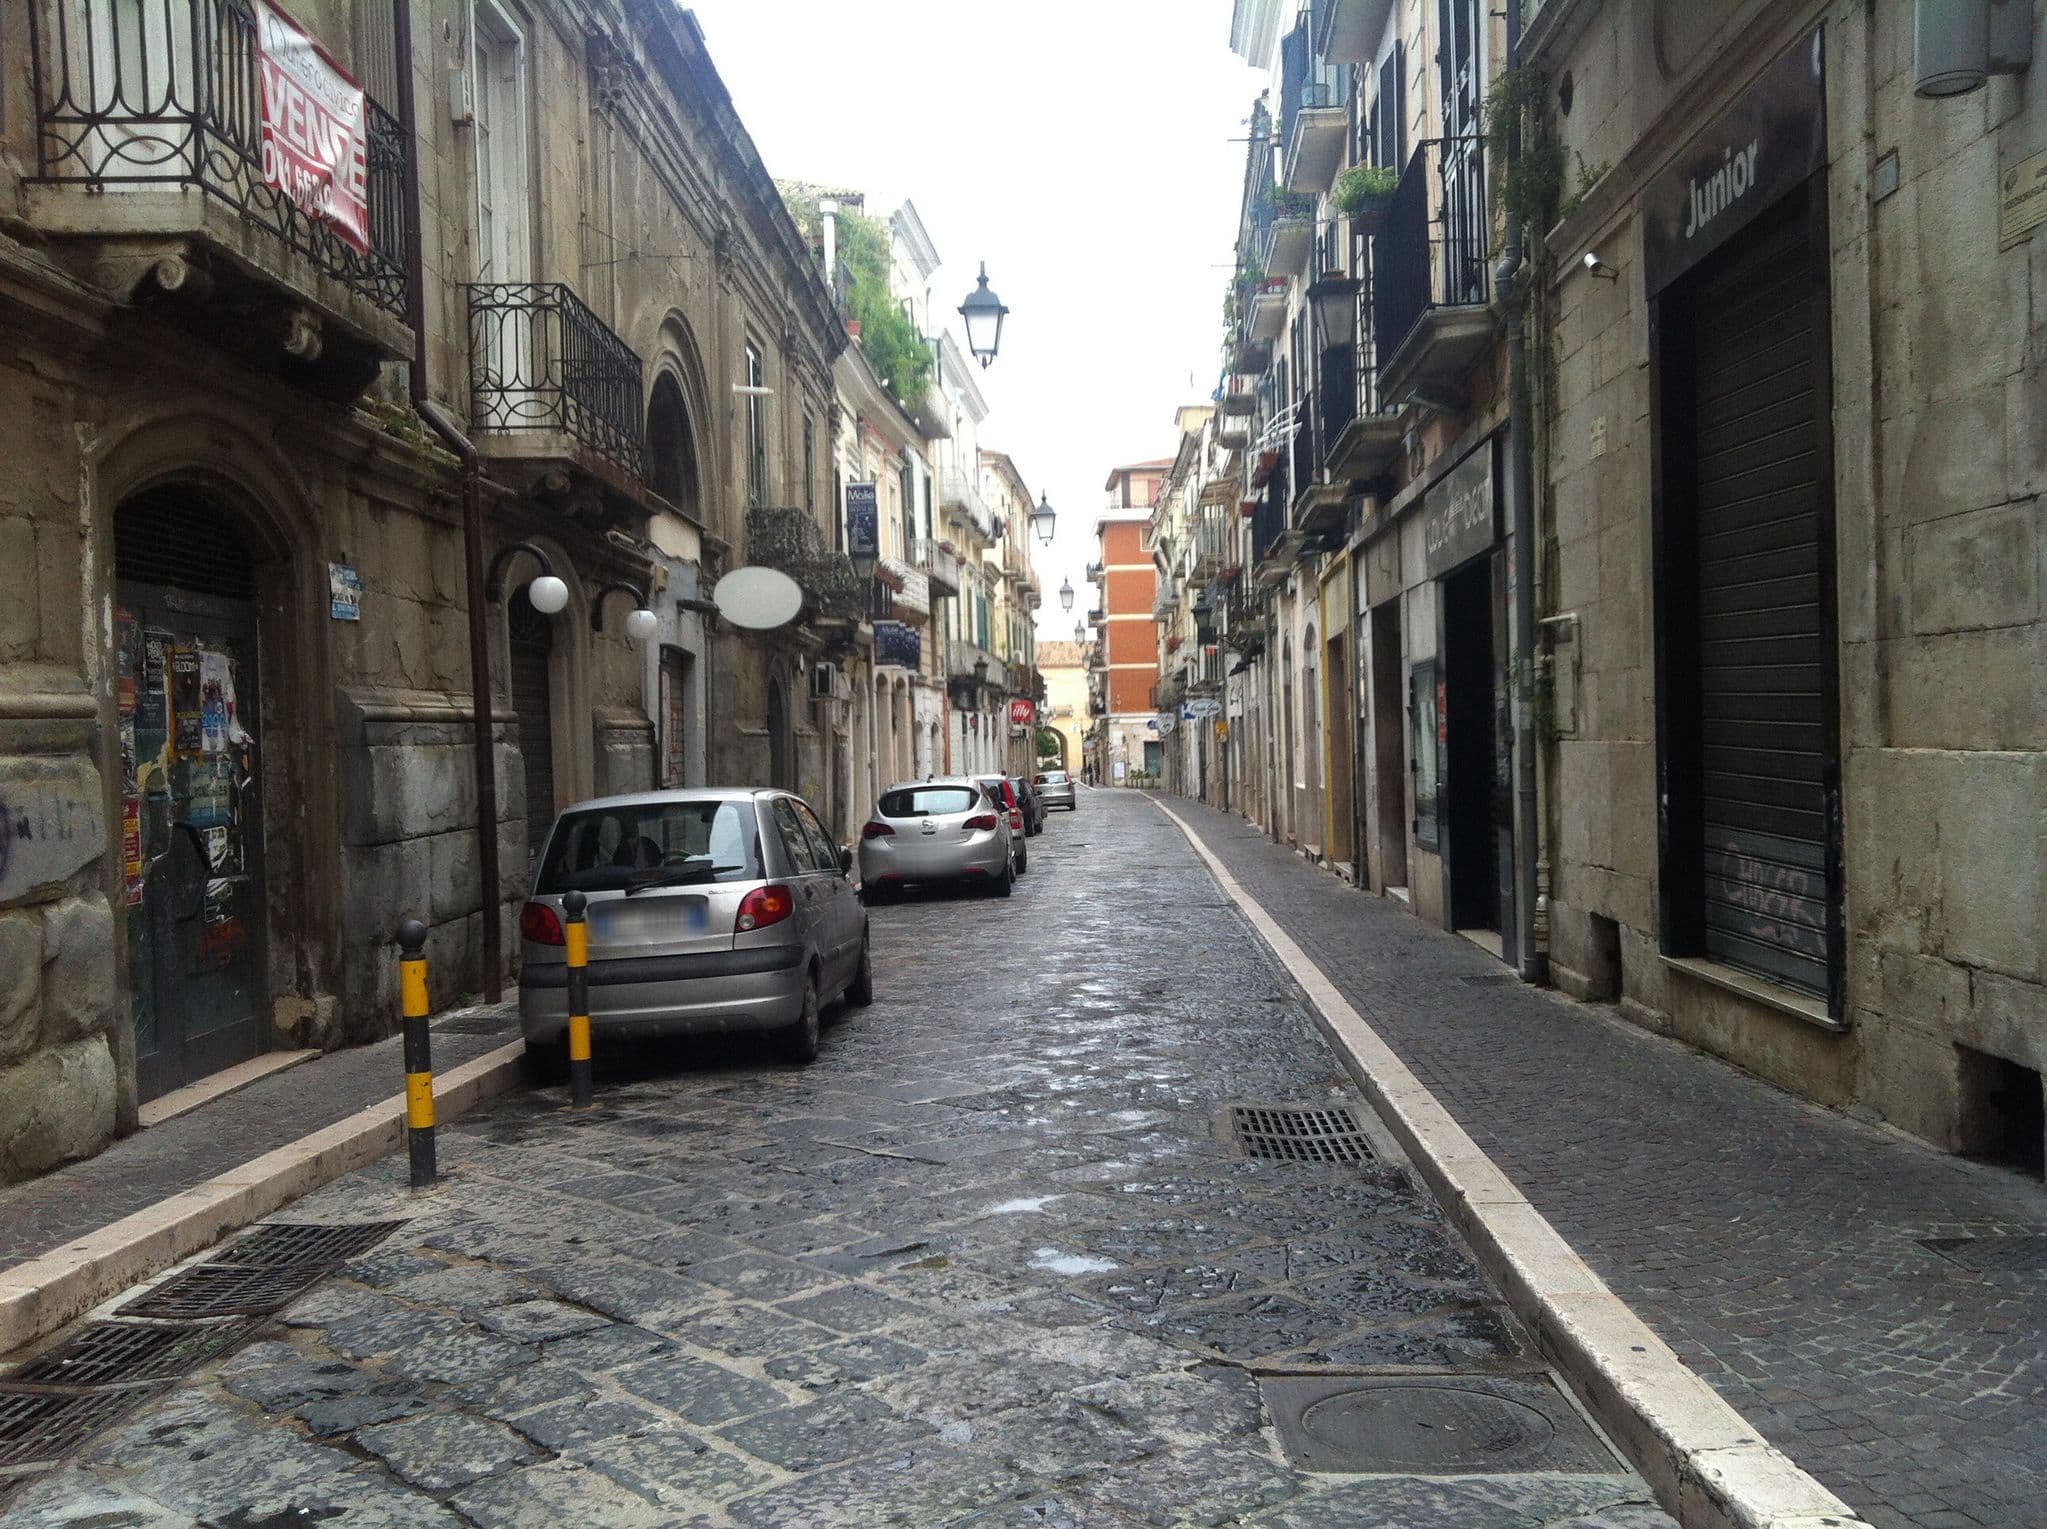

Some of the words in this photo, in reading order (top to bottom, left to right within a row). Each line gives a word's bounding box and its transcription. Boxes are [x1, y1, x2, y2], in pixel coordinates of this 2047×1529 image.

[261, 56, 367, 202] VENDE
[1685, 137, 1758, 239] Junior
[1012, 703, 1031, 721] illy
